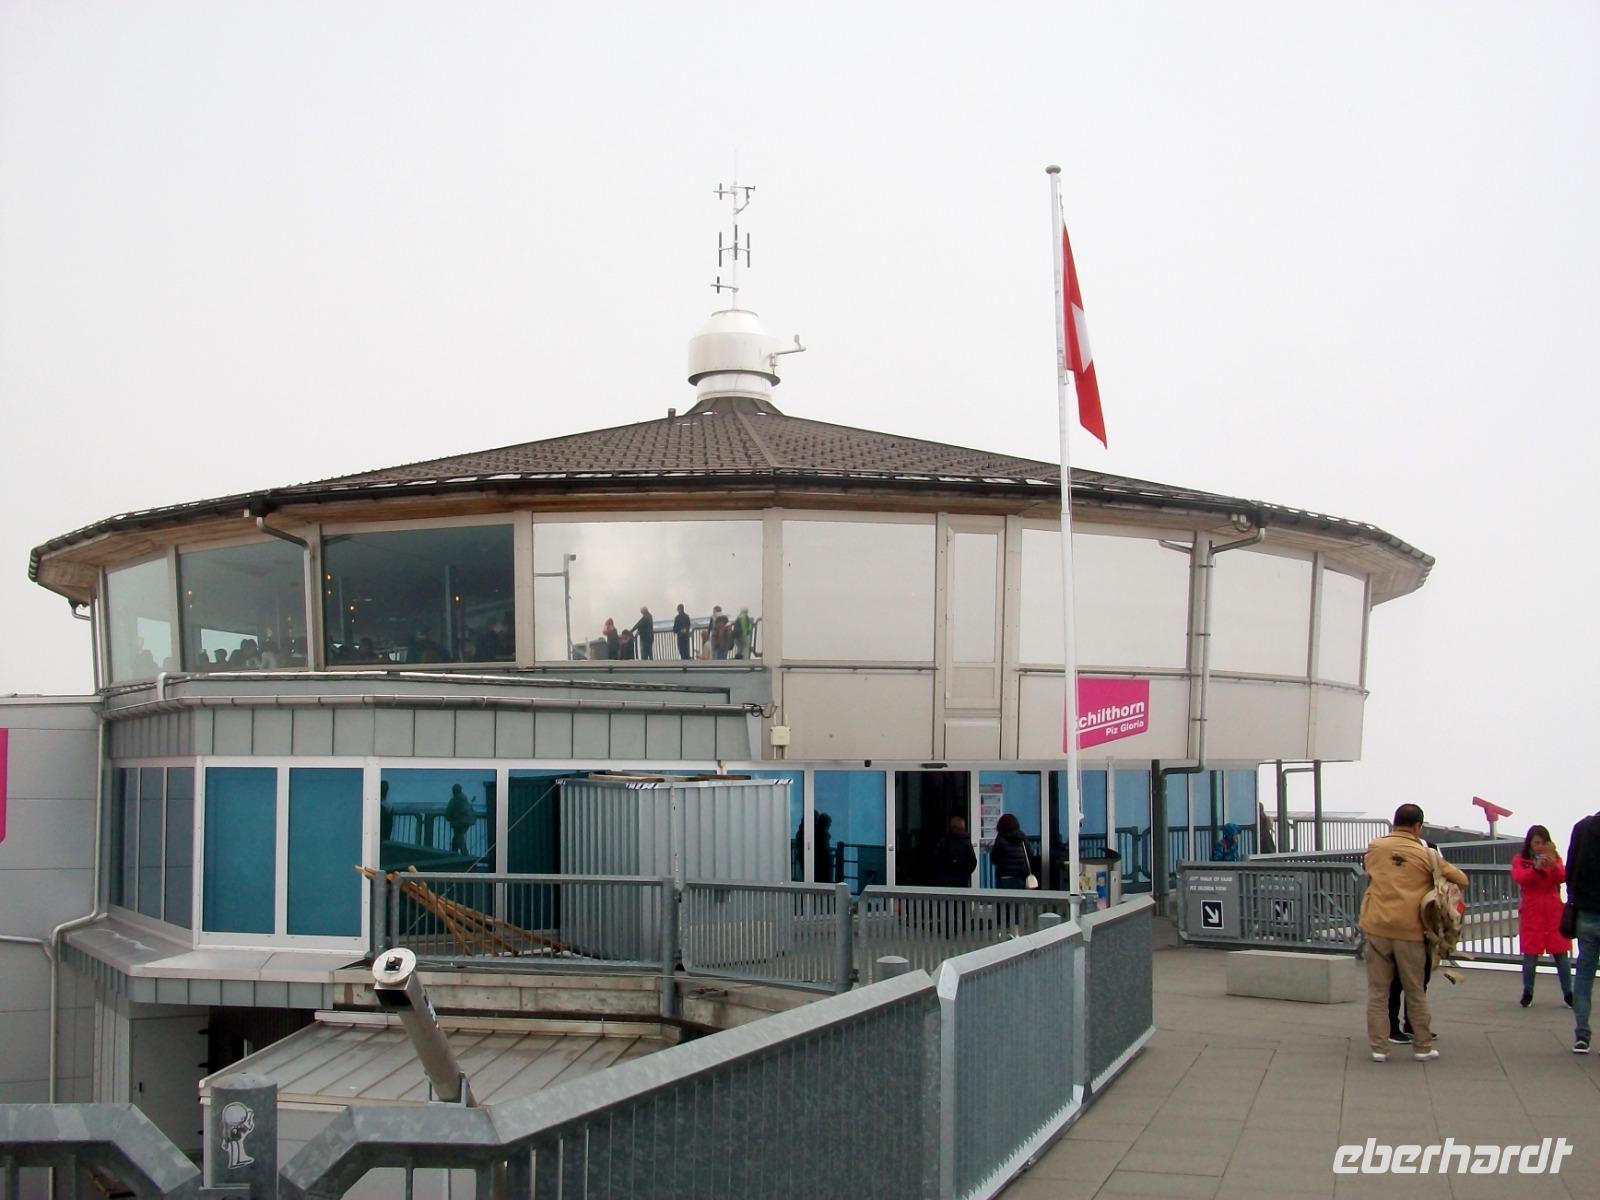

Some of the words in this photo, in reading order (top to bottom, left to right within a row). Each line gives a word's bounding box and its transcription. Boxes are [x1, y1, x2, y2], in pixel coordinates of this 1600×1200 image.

[1077, 701, 1145, 728] chilthorn
[1105, 726, 1118, 736] Piz
[1120, 720, 1144, 732] Gloria
